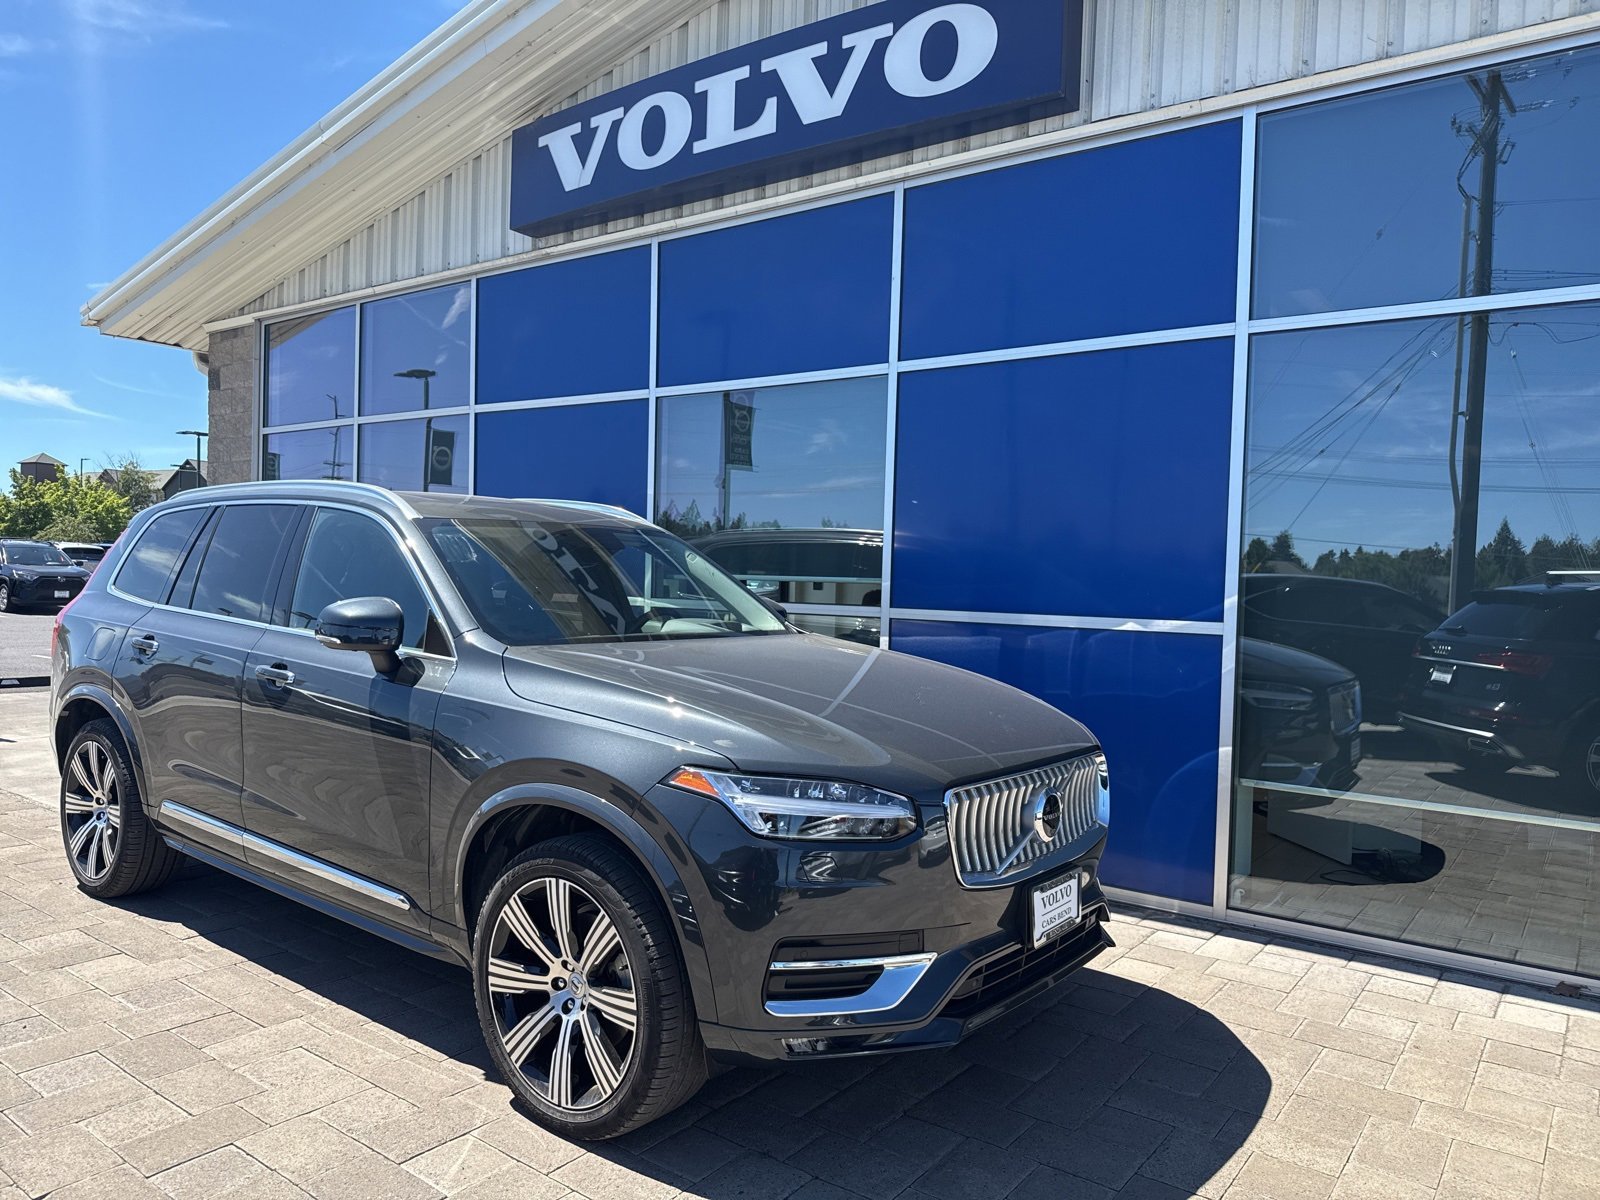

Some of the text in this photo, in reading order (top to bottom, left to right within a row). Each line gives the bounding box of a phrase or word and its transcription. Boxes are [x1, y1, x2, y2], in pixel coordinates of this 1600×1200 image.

[538, 3, 998, 192] VOLVO
[1041, 884, 1072, 909] VOLVO
[1041, 907, 1072, 929] CARS BEND
